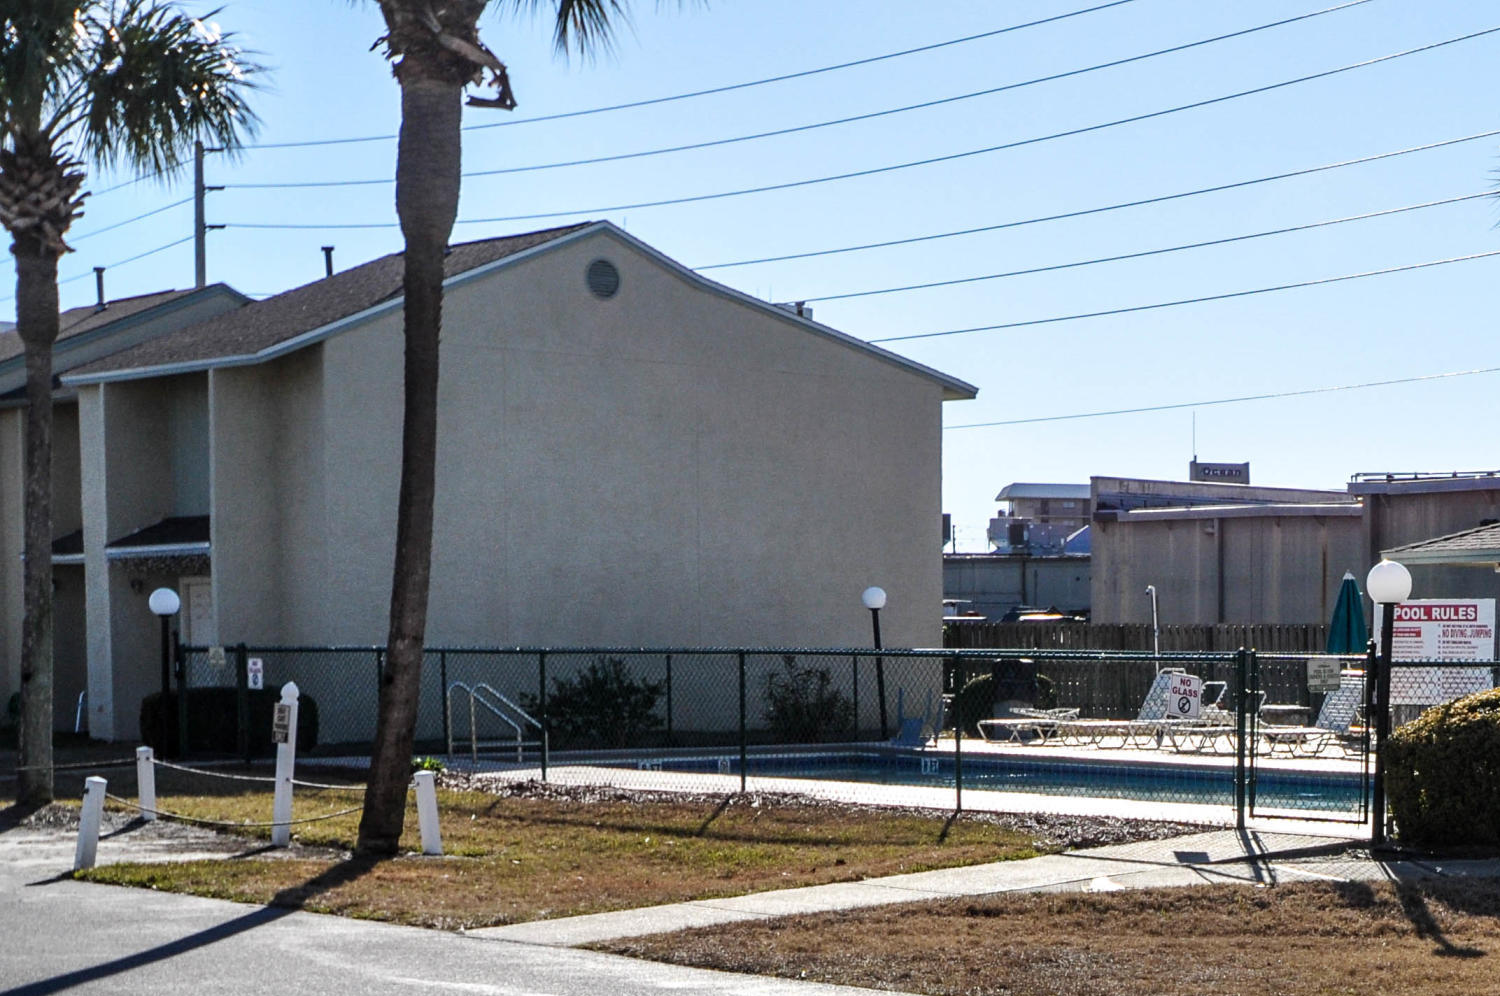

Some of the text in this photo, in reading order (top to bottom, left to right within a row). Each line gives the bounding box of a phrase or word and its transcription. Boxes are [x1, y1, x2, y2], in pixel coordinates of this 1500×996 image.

[1393, 607, 1476, 620] POOL RULES
[1180, 677, 1192, 688] NO
[1172, 686, 1198, 698] GLASS
